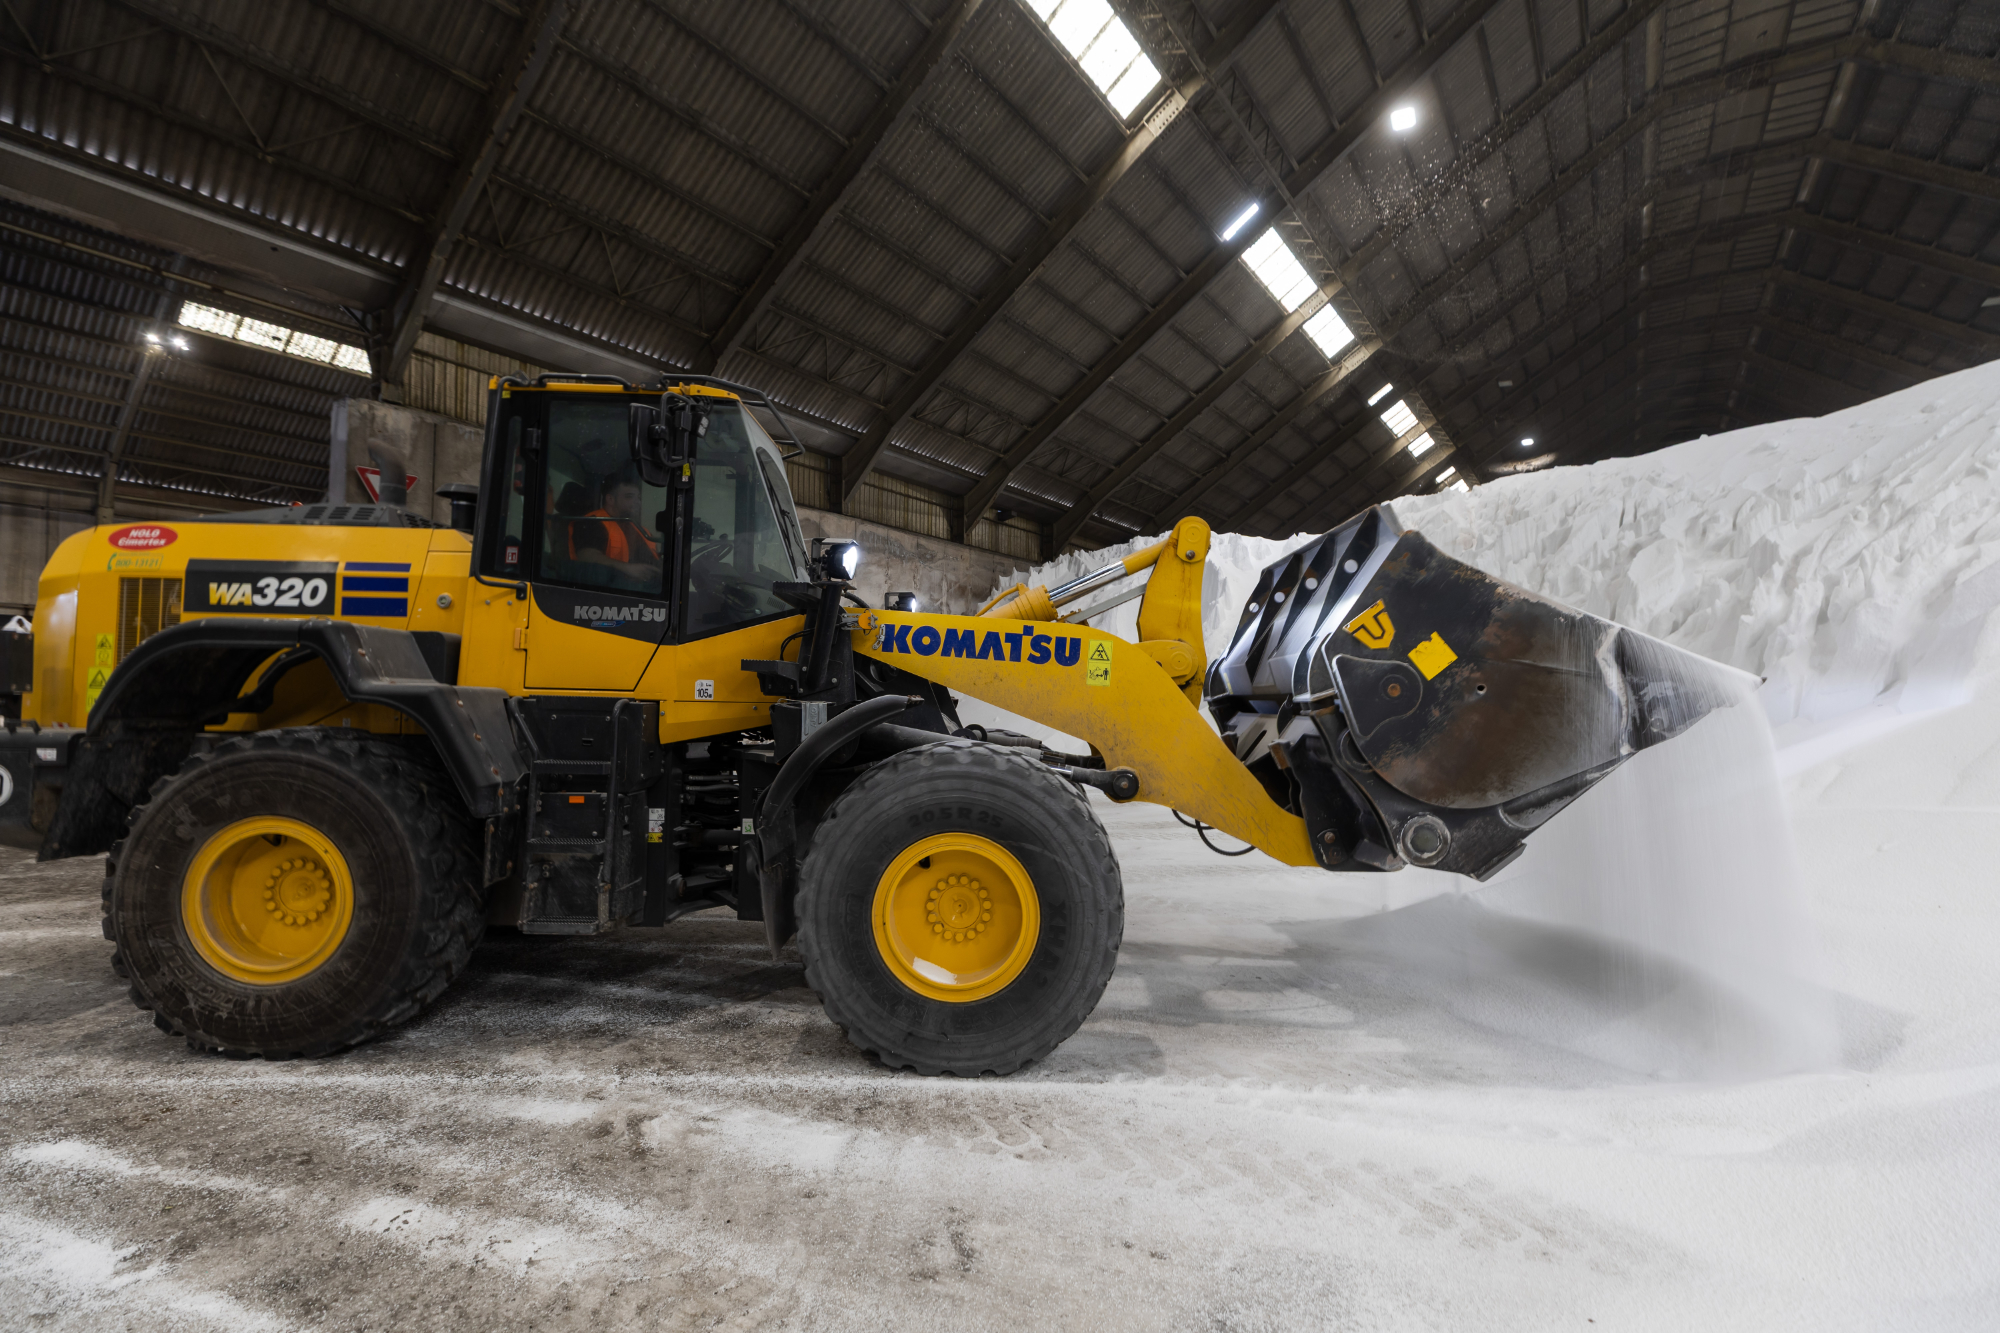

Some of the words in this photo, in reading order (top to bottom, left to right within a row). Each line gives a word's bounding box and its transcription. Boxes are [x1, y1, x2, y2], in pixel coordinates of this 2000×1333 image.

[118, 537, 167, 547] Cimertex
[209, 576, 328, 608] WA320
[574, 603, 667, 623] KOMATSU
[881, 624, 1082, 667] KOMATSU
[696, 688, 709, 699] 105
